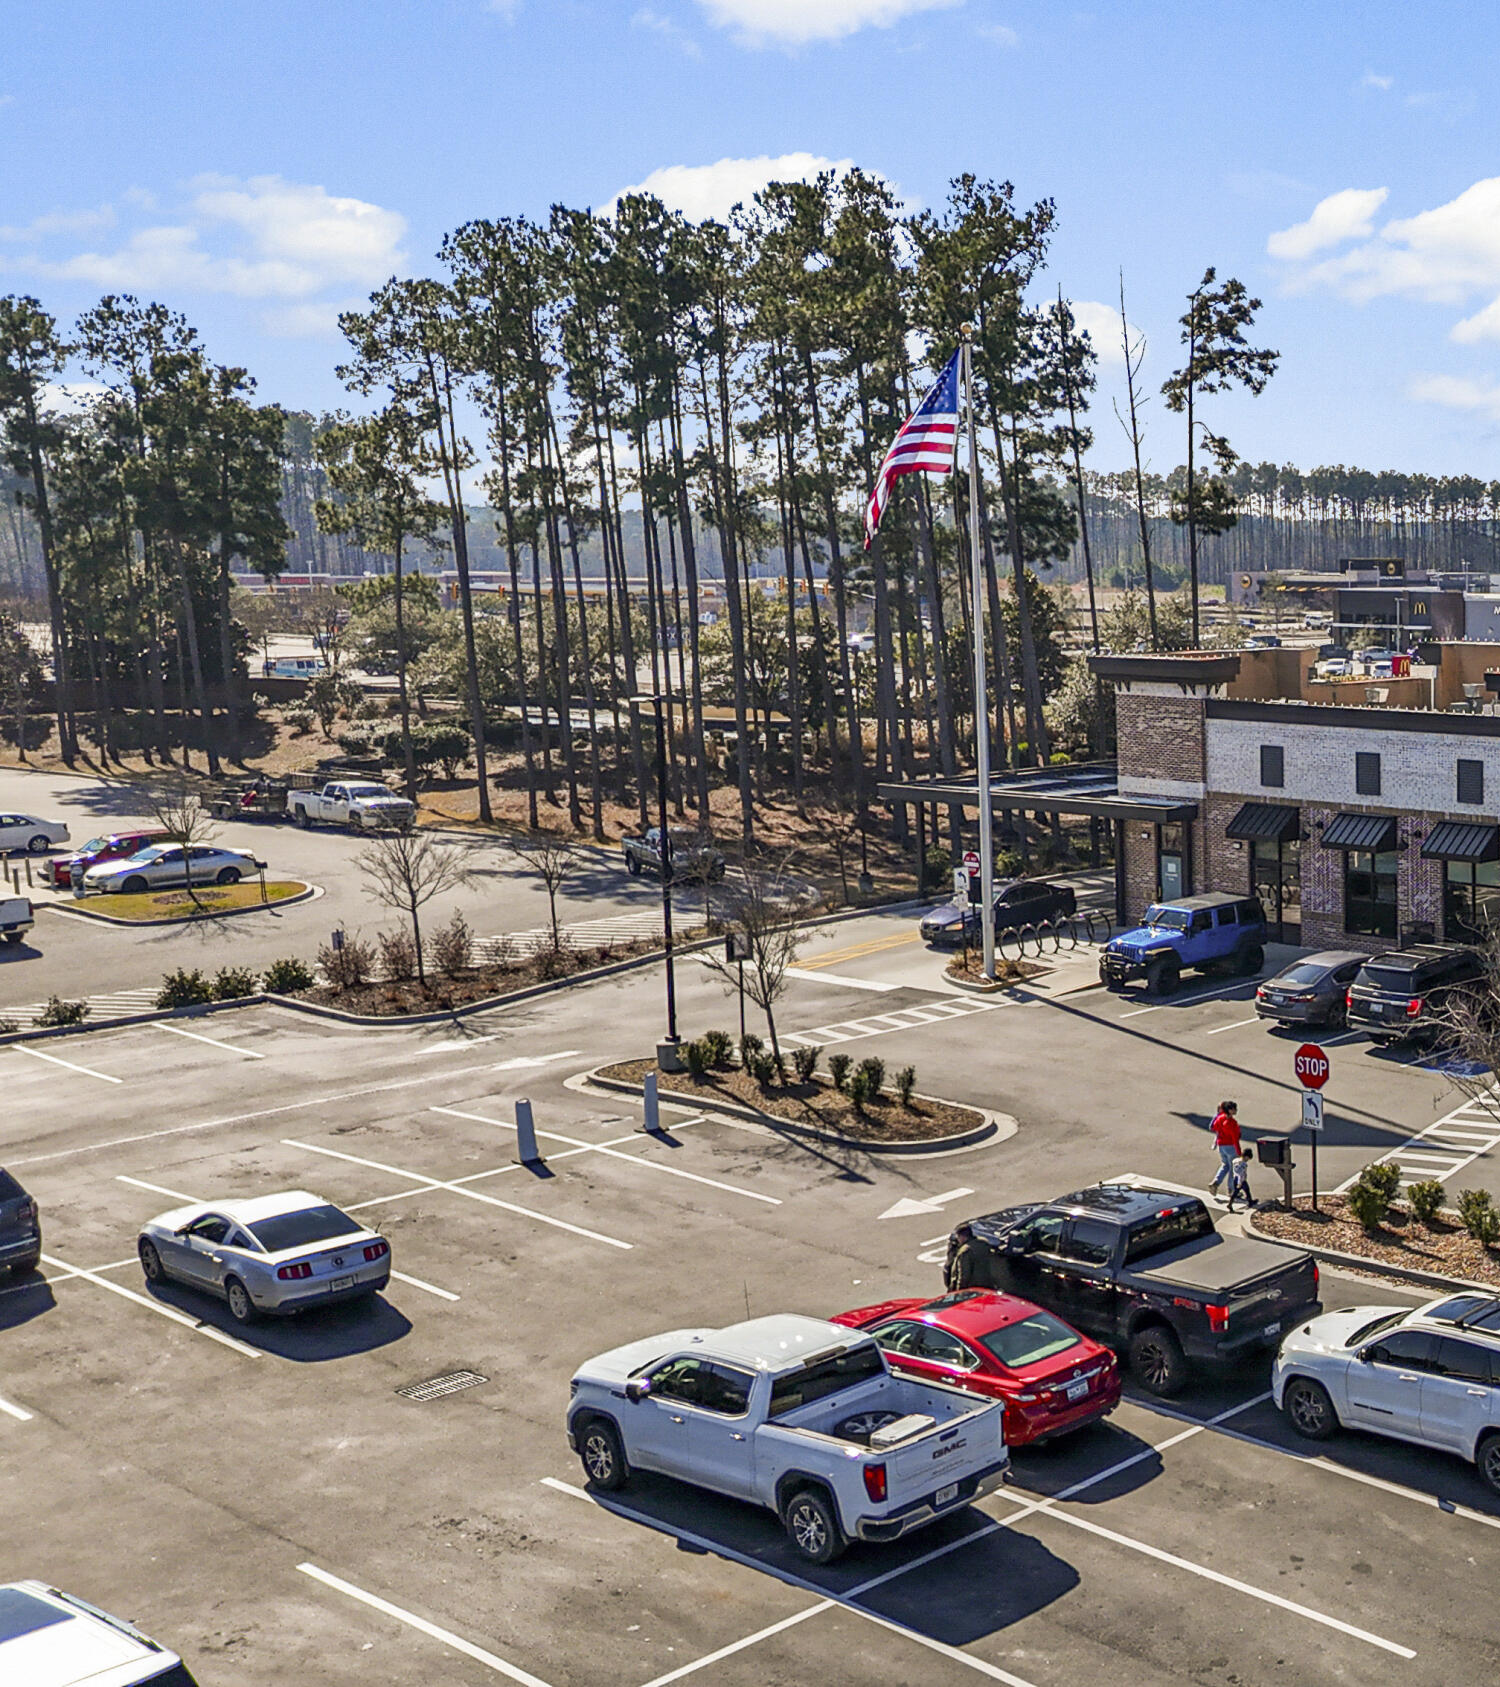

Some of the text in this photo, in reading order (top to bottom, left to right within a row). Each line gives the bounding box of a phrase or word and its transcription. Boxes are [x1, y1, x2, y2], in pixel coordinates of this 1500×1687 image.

[1296, 1055, 1328, 1077] STOP
[1304, 1117, 1321, 1127] ONLY
[932, 1438, 967, 1459] GMC
